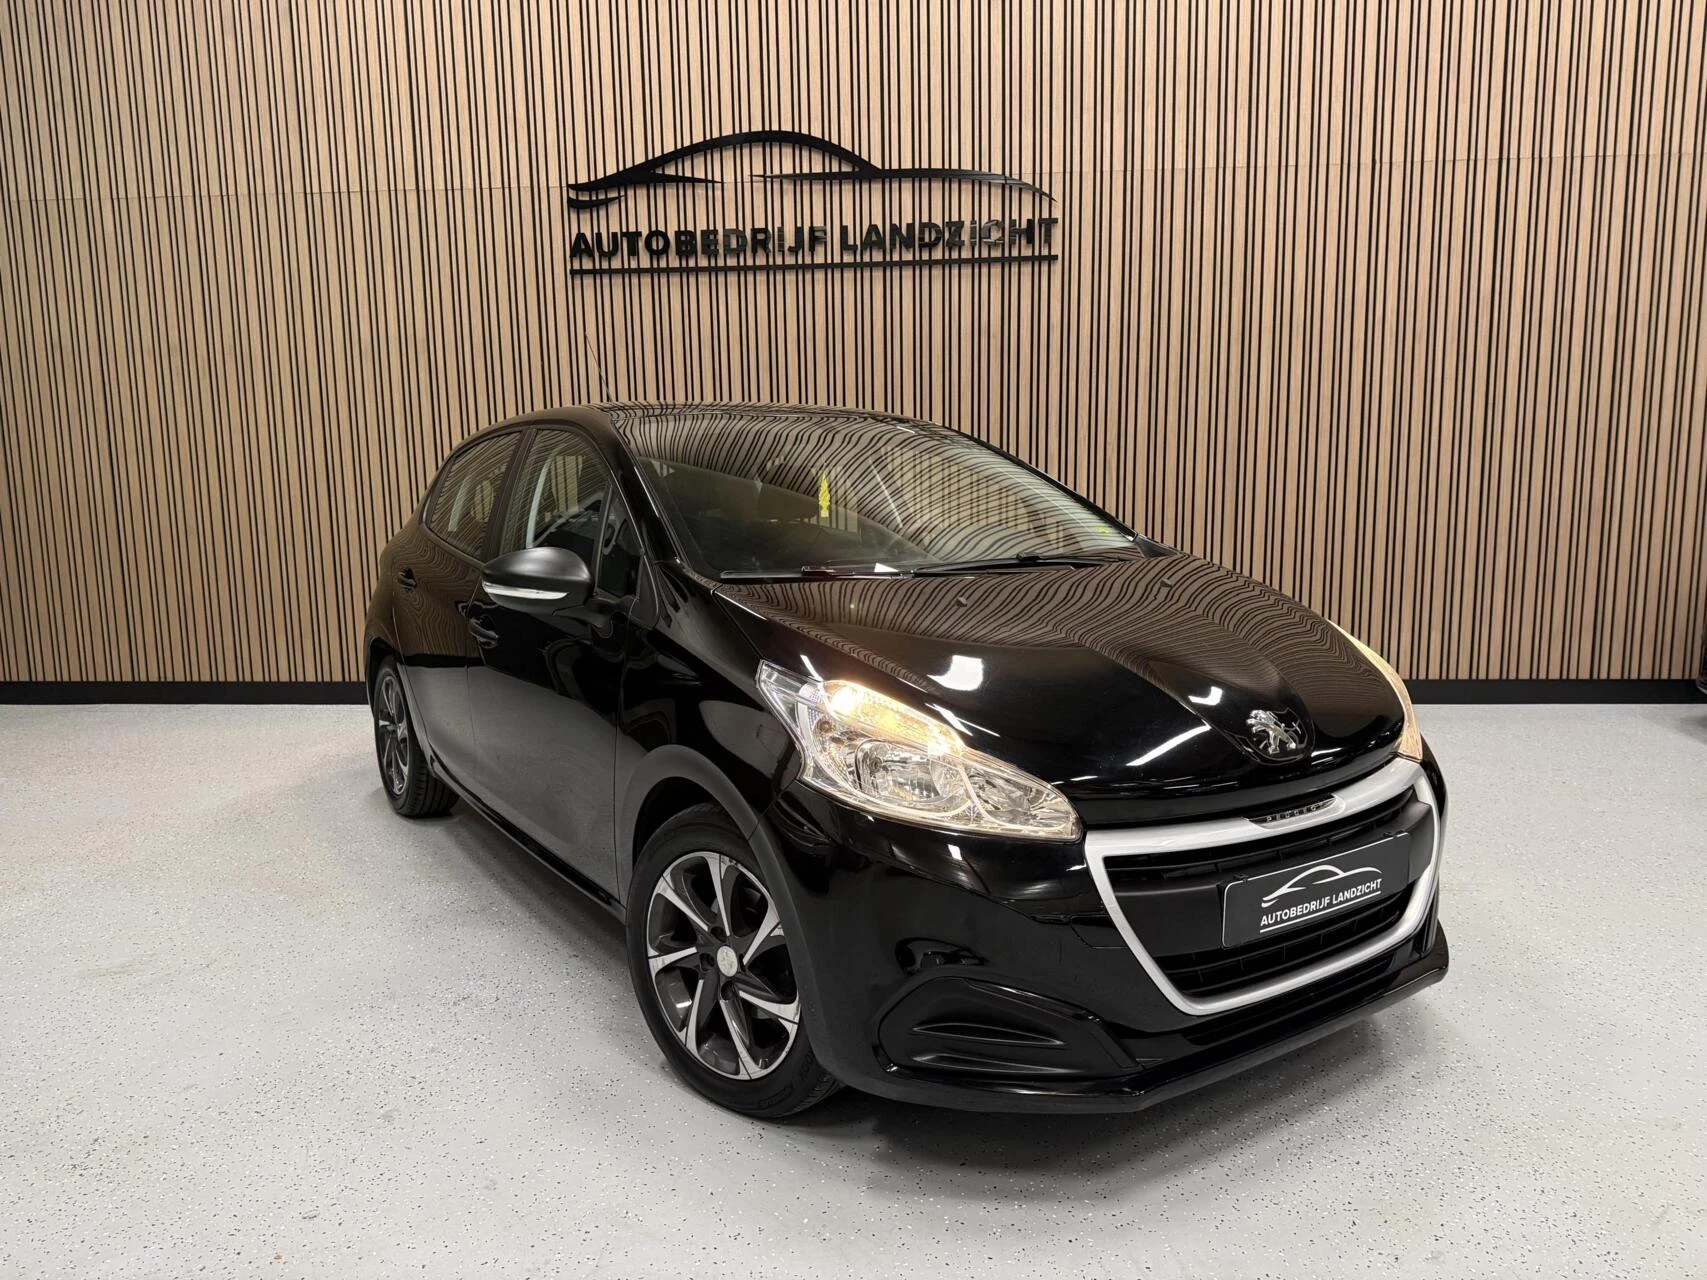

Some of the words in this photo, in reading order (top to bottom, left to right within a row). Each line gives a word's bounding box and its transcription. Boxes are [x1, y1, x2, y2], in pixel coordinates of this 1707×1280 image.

[570, 226, 826, 258] AUTOBEDRIJF
[840, 217, 1059, 252] LANDZICHT
[1260, 896, 1331, 926] AUTOBEDRIJF
[1332, 878, 1383, 905] LANDZICHT
